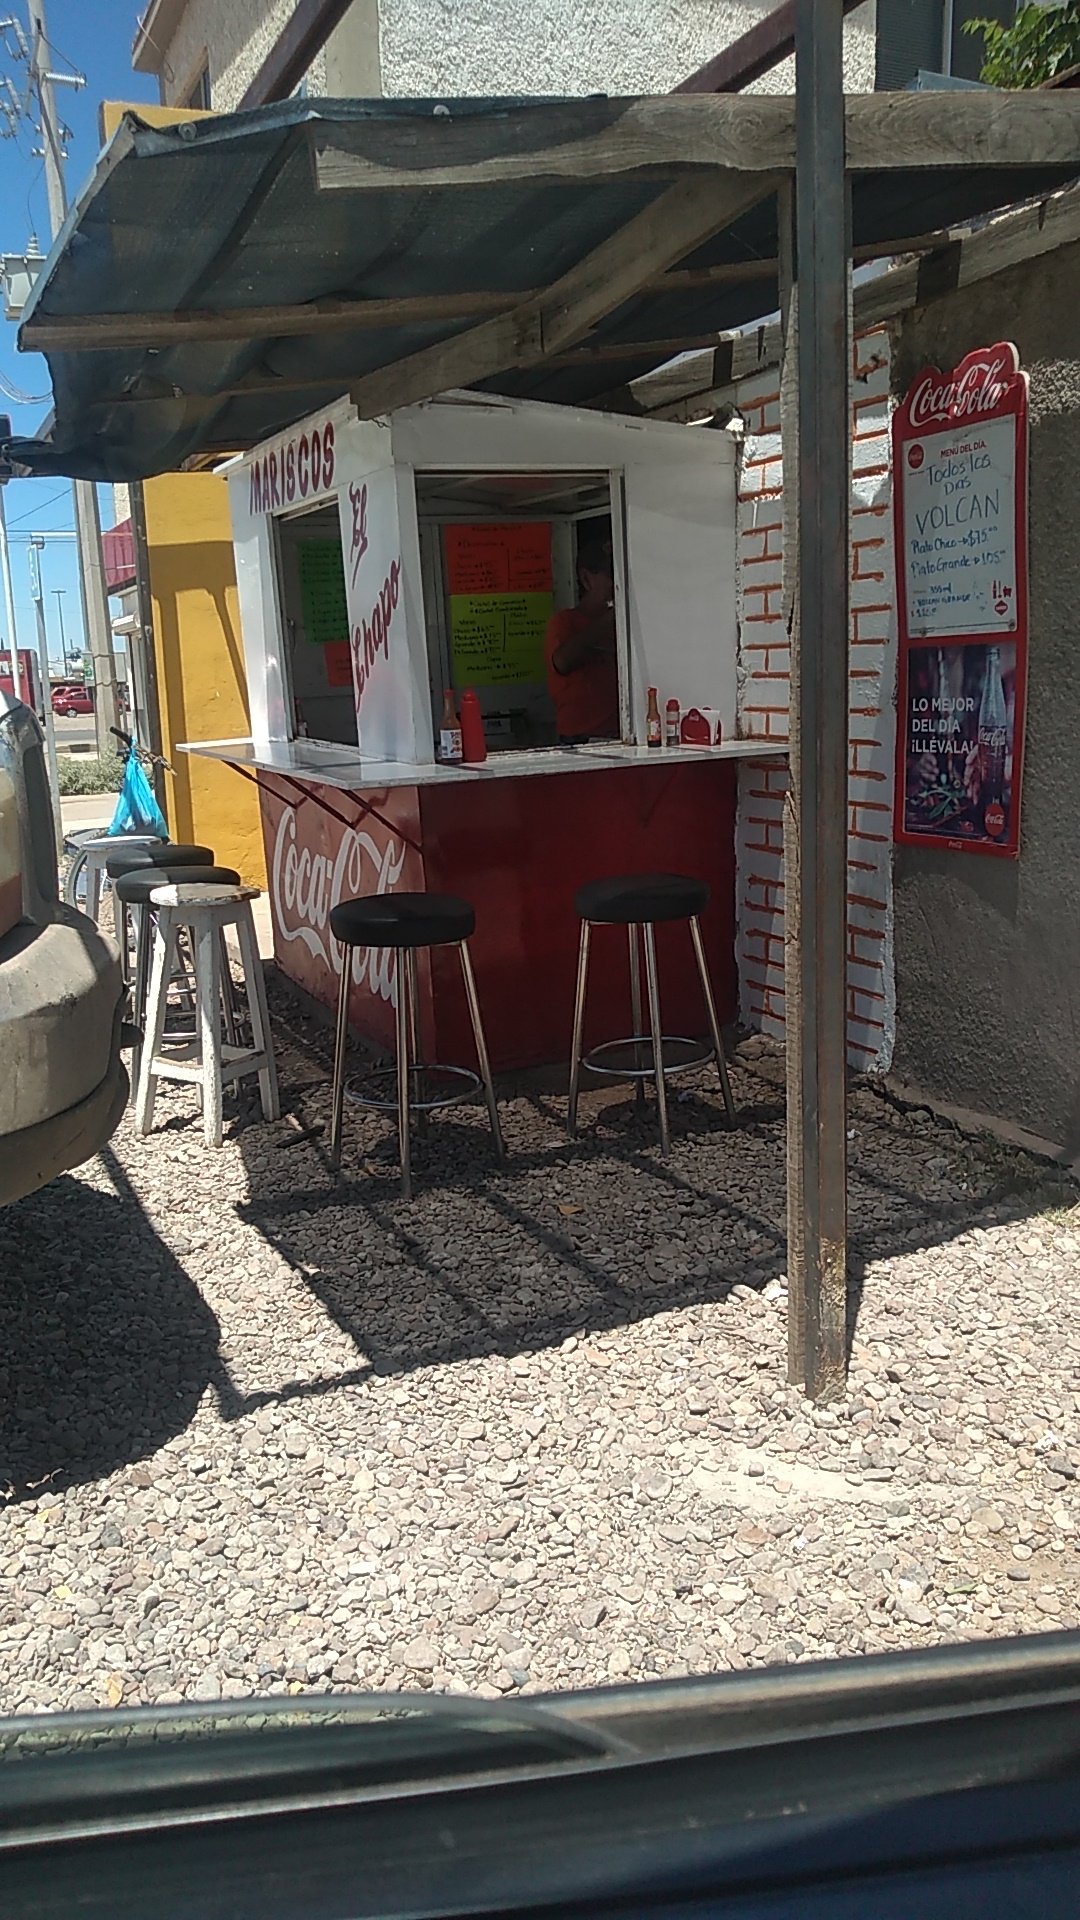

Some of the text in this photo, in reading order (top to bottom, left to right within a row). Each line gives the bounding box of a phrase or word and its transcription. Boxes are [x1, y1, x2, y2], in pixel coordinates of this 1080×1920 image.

[960, 444, 973, 454] DEL
[250, 421, 335, 516] MARISCOS
[927, 453, 992, 486] Todos los
[915, 488, 999, 535] VOLCAN
[911, 539, 934, 555] Plato
[936, 554, 971, 573] Grande
[351, 556, 400, 713] Chapo
[912, 697, 974, 712] LO MEJOR
[912, 718, 936, 733] DEL
